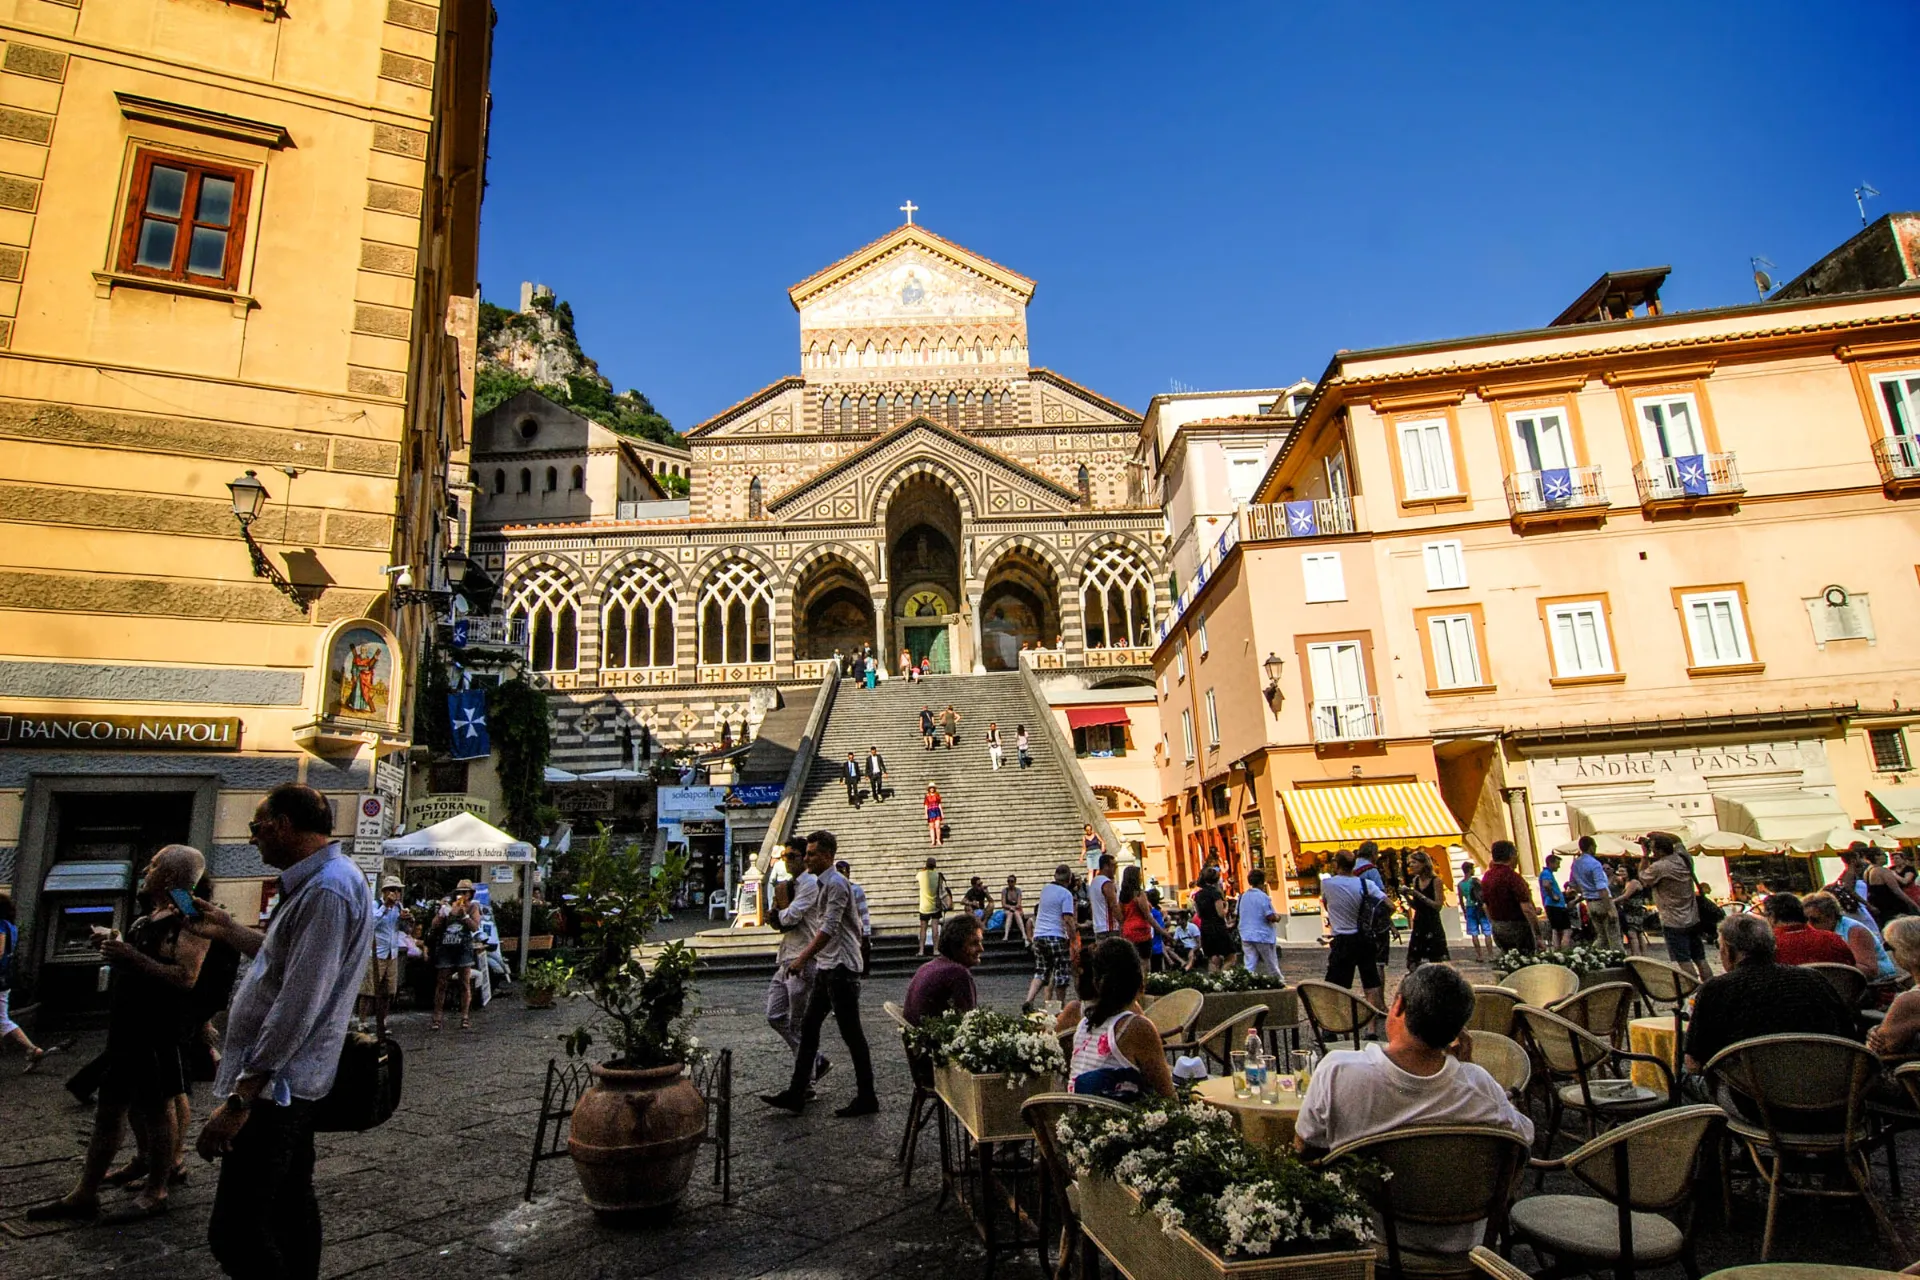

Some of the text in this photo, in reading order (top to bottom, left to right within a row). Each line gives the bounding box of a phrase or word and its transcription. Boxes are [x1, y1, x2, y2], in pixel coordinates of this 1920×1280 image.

[20, 719, 113, 740] BANCO
[138, 722, 230, 742] NAPOLI
[1575, 752, 1778, 778] ANDREA PANSA
[412, 802, 486, 814] RISTORANTE
[435, 847, 475, 859] Festeggiamenti
[484, 848, 502, 857] Andrea
[503, 847, 527, 860] Apostolo
